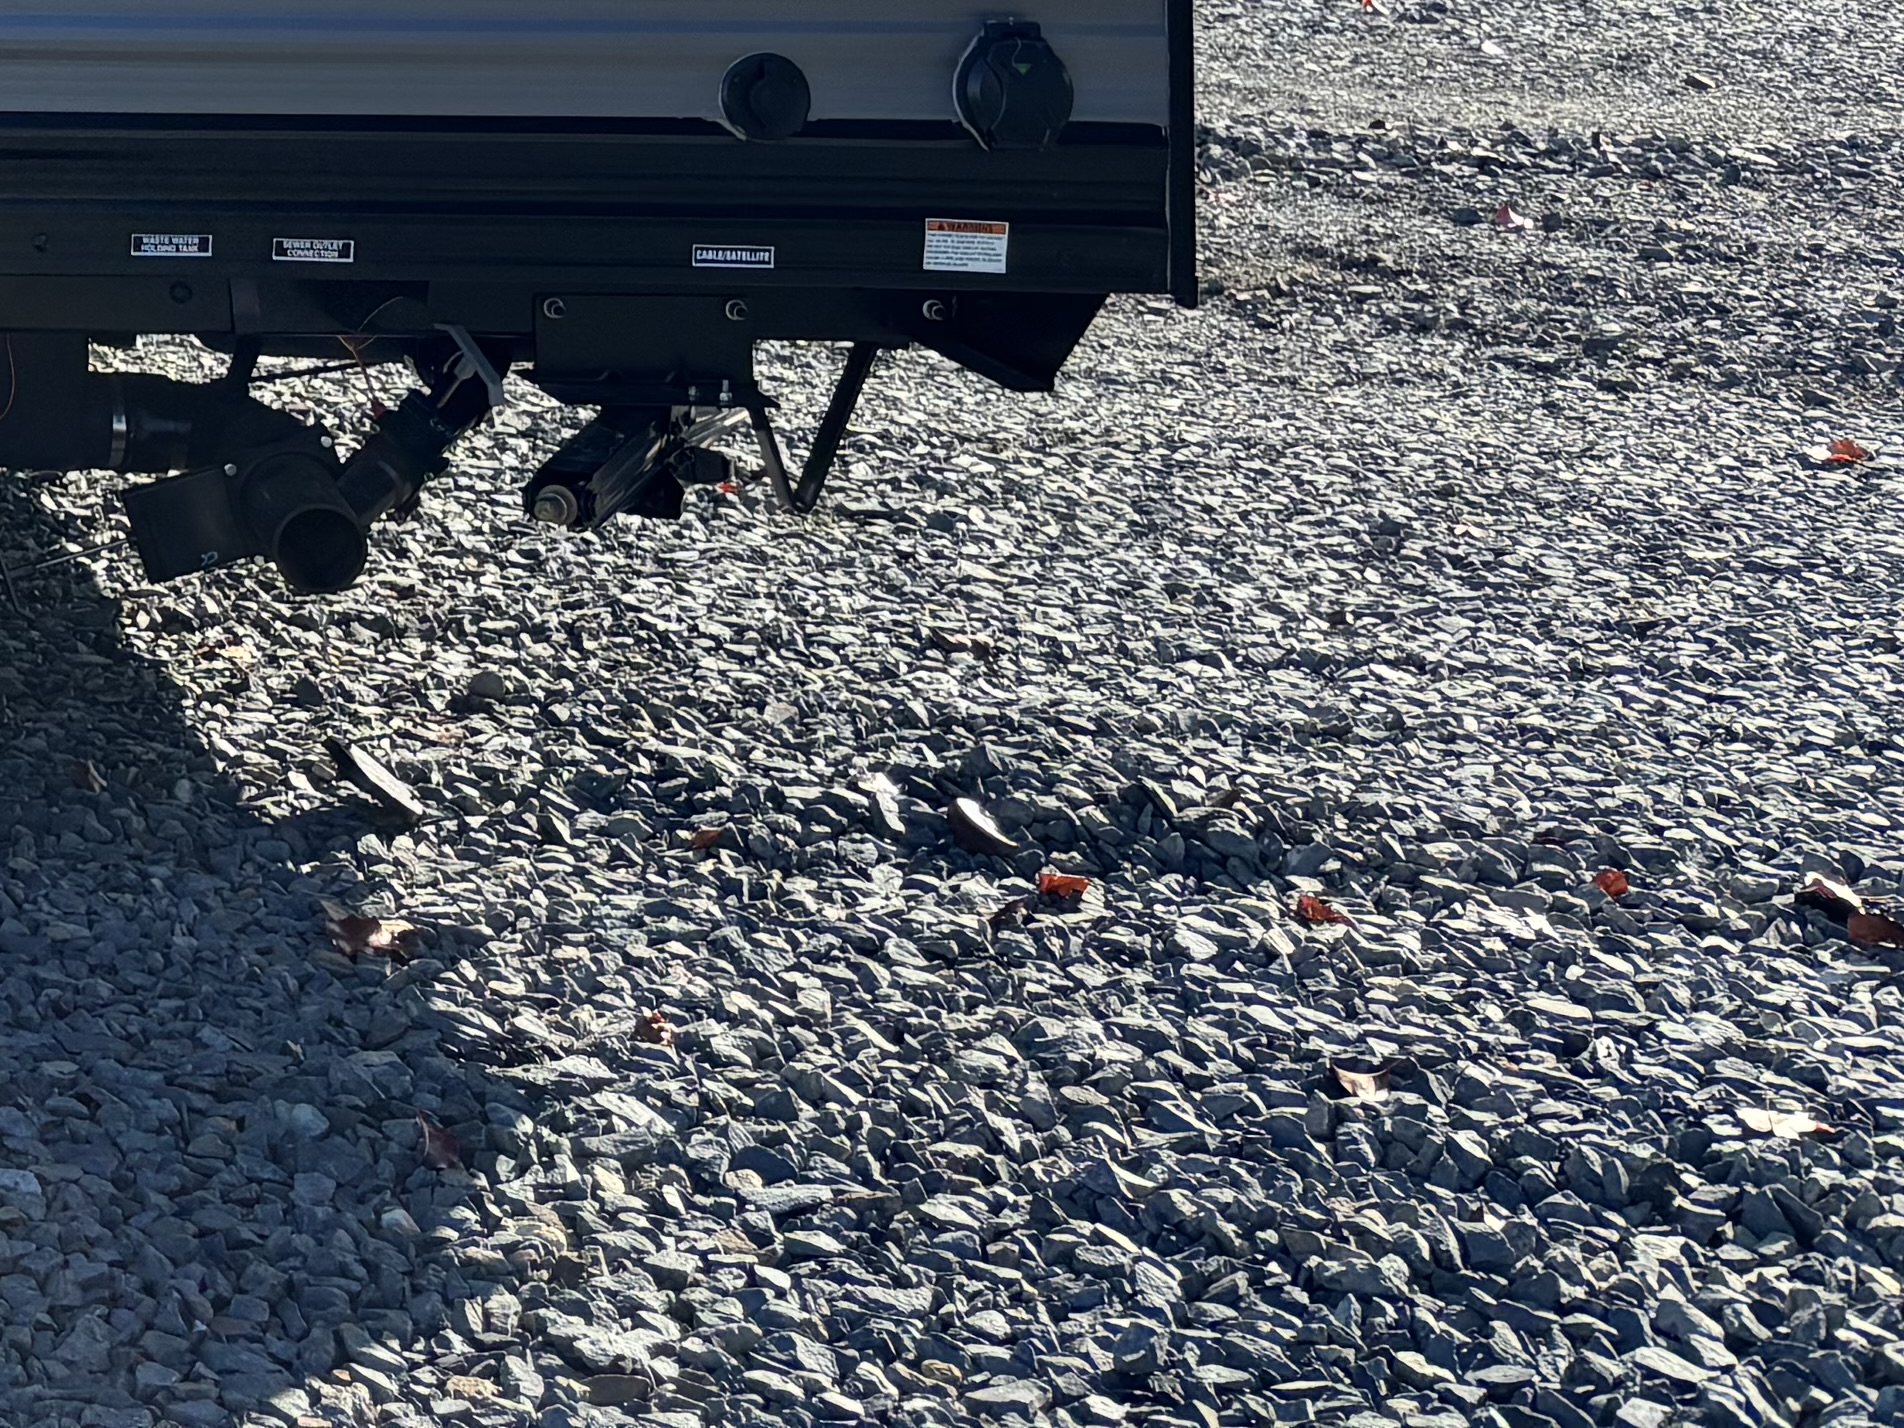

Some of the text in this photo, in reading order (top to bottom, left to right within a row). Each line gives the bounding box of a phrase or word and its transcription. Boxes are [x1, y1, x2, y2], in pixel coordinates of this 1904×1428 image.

[142, 236, 200, 245] WASTE WATER
[283, 240, 343, 251] SEWER OUTLET
[141, 244, 199, 253] HOLDING TANK
[286, 249, 339, 259] CONNECTION
[696, 249, 770, 262] CABLE/SATELLITE
